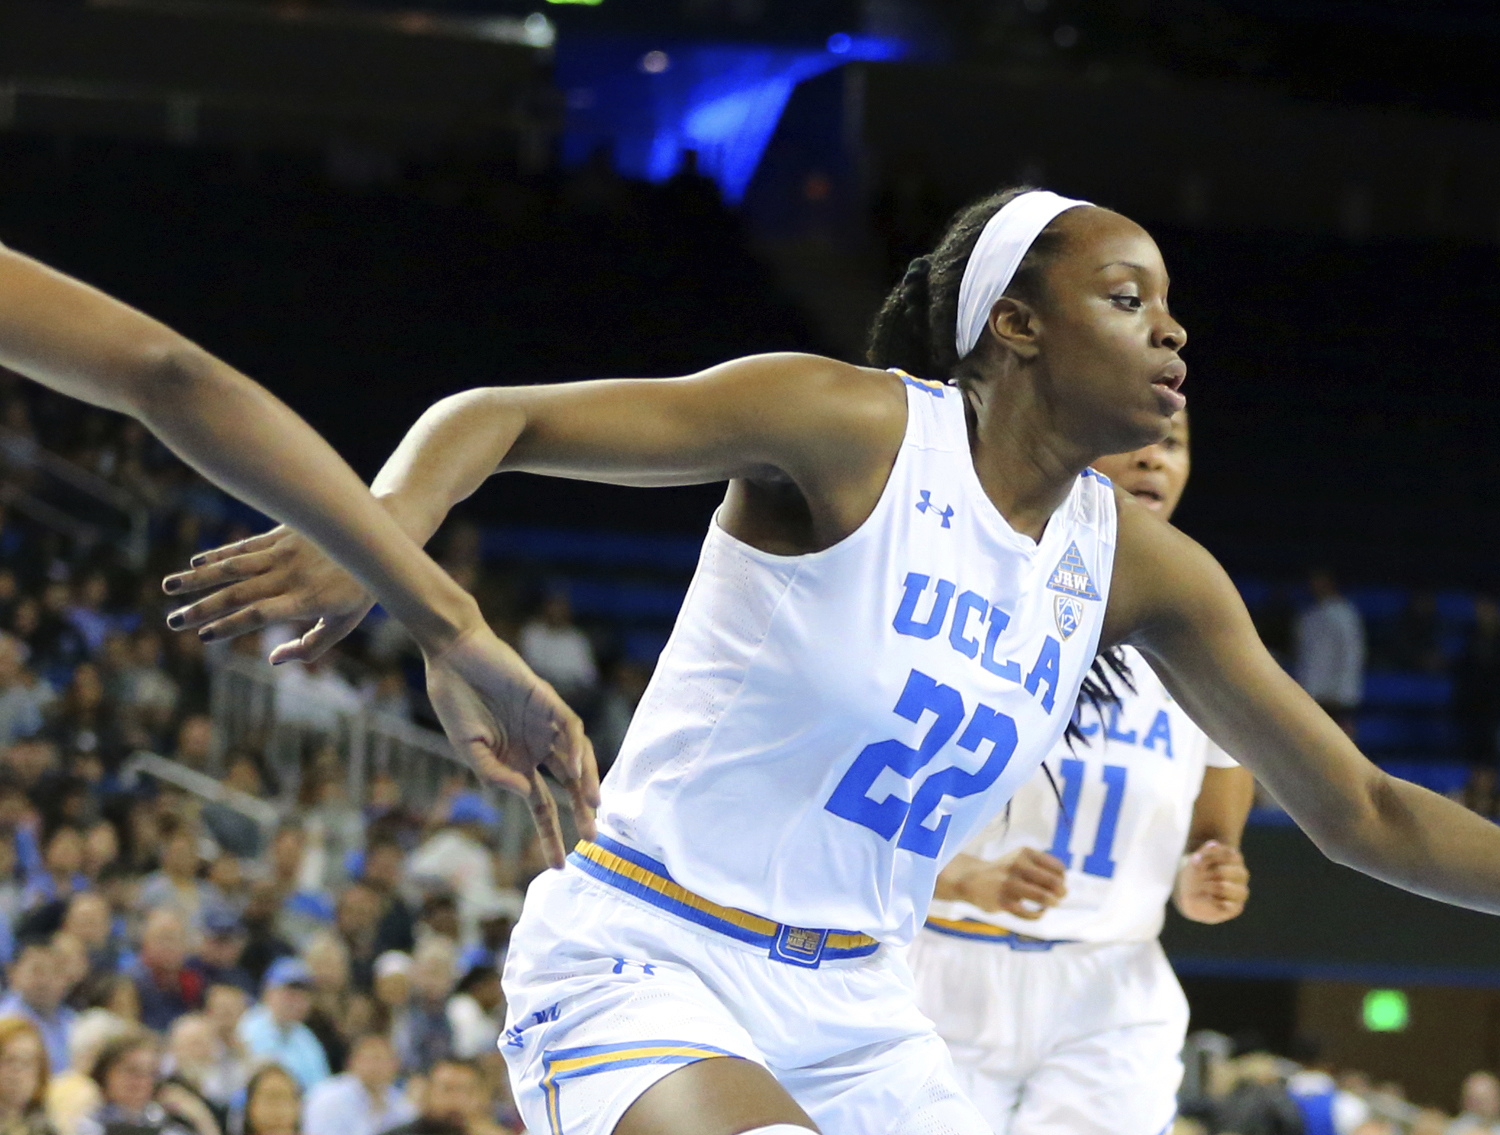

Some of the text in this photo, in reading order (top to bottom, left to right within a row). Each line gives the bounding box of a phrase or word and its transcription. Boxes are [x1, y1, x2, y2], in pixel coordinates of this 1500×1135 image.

[1054, 571, 1089, 592] JRW
[1060, 613, 1075, 632] 12
[892, 572, 1061, 715] UCLA
[824, 668, 1019, 859] 22
[1070, 692, 1174, 759] CLA
[1046, 759, 1128, 879] 11
